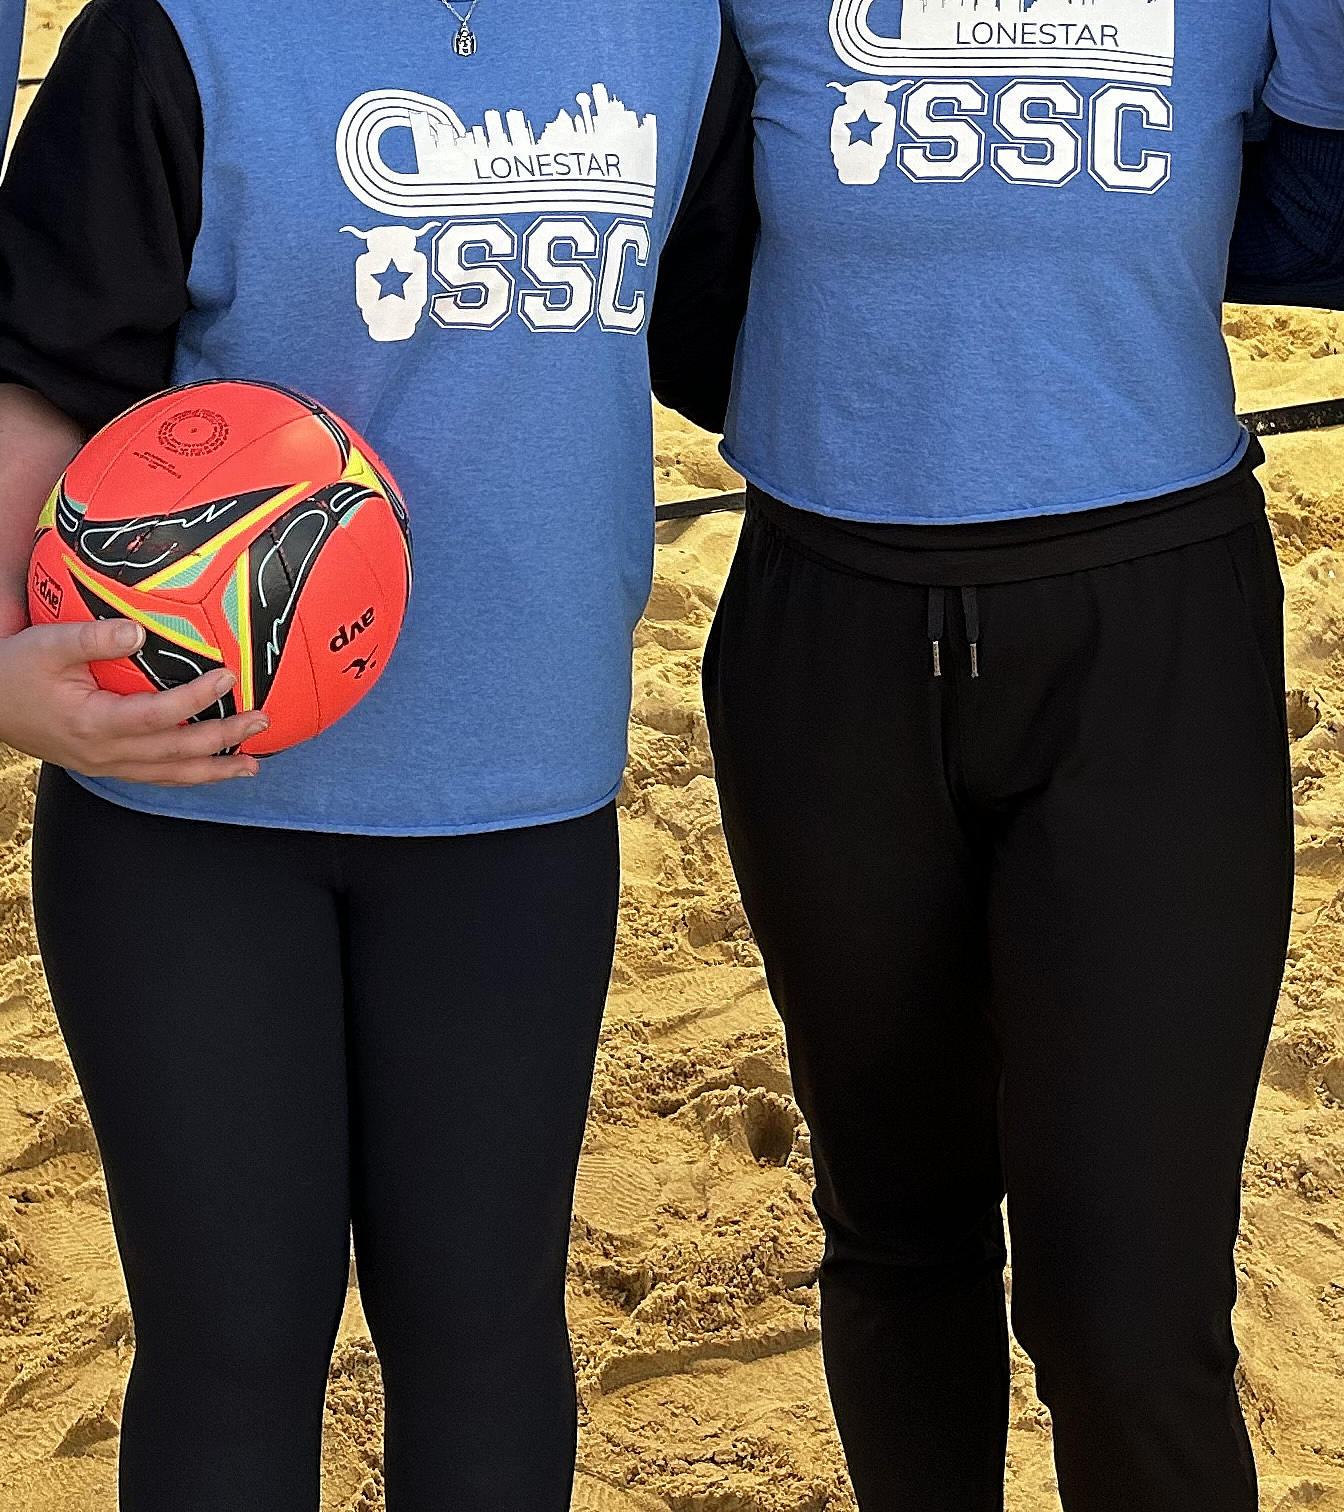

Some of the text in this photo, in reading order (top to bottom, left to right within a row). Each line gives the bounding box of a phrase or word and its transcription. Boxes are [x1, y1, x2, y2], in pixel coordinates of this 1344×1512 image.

[956, 21, 1119, 48] LONESTAR
[897, 79, 1173, 194] SSC
[474, 153, 622, 179] LONESTAR
[429, 216, 650, 335] SSC
[330, 606, 375, 652] avp
